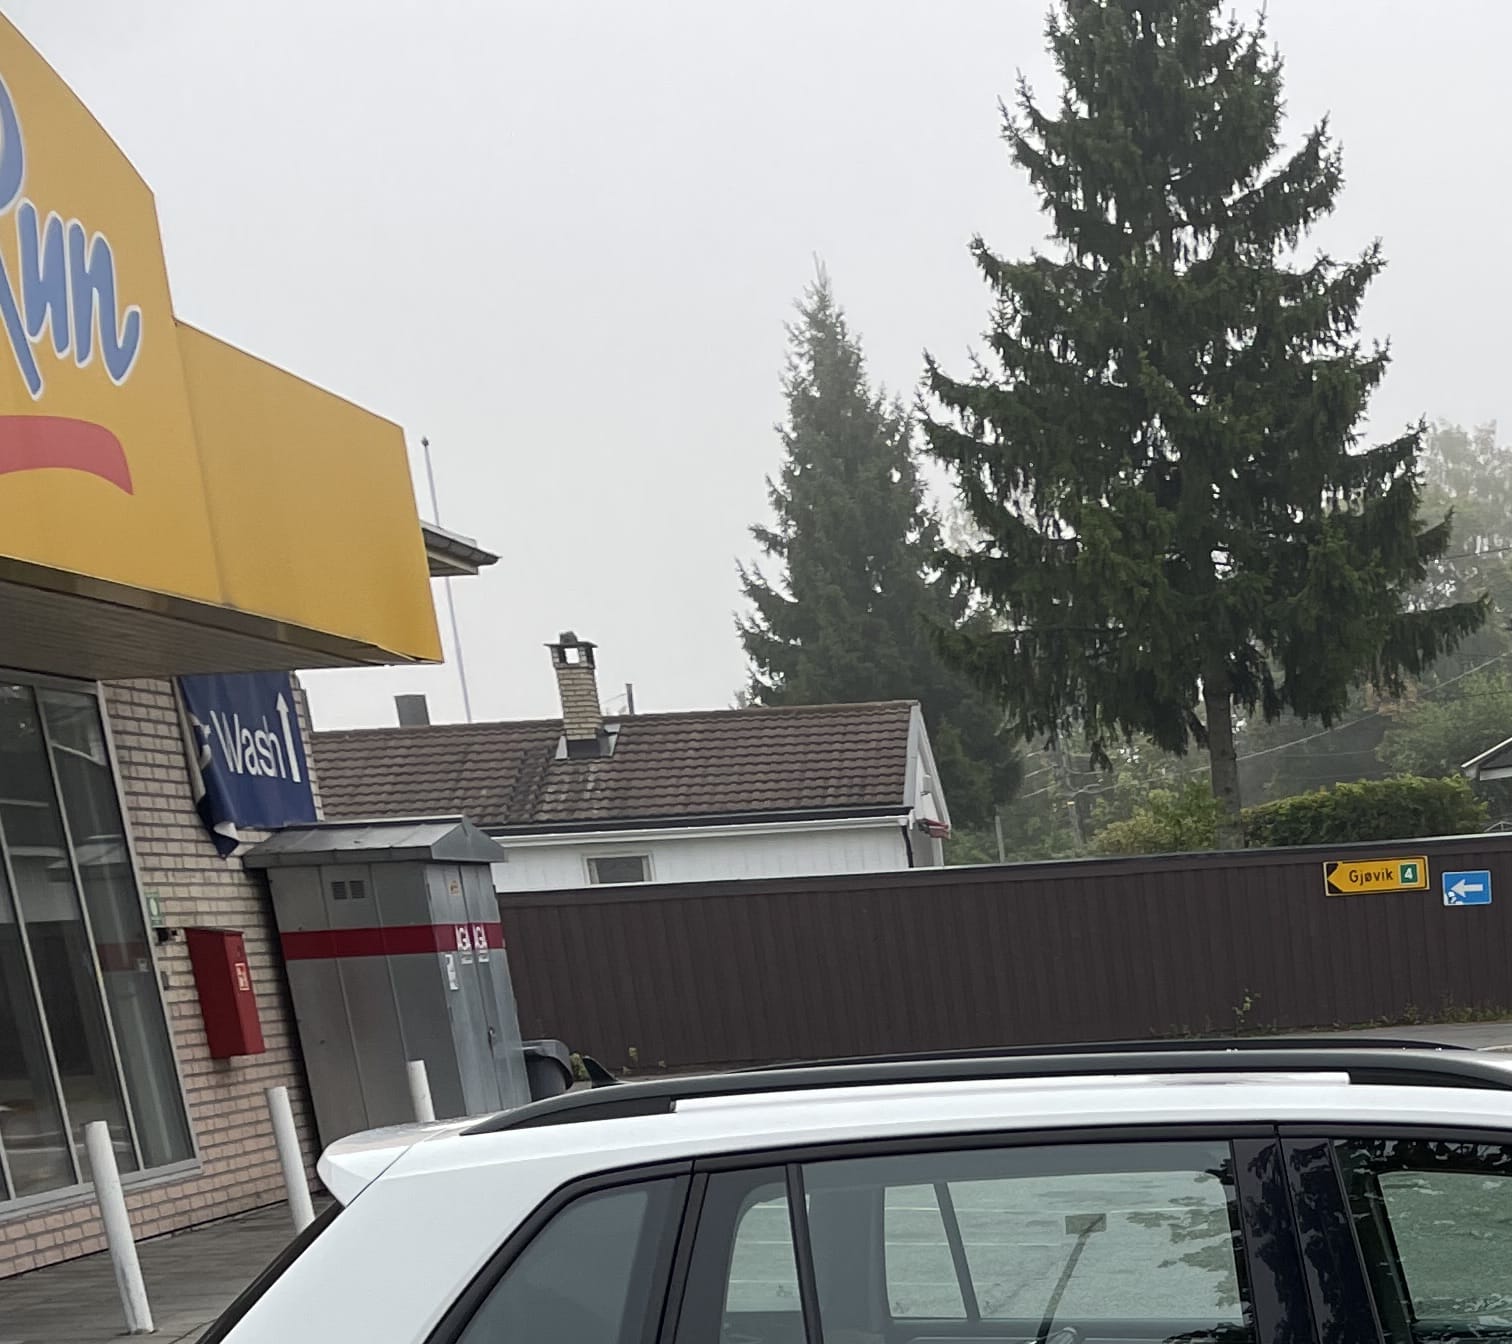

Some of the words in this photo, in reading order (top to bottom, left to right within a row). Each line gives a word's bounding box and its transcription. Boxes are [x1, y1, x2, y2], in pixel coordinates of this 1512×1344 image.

[210, 710, 286, 779] Wash
[1350, 869, 1393, 885] Gjøvik
[1404, 867, 1413, 880] 4
